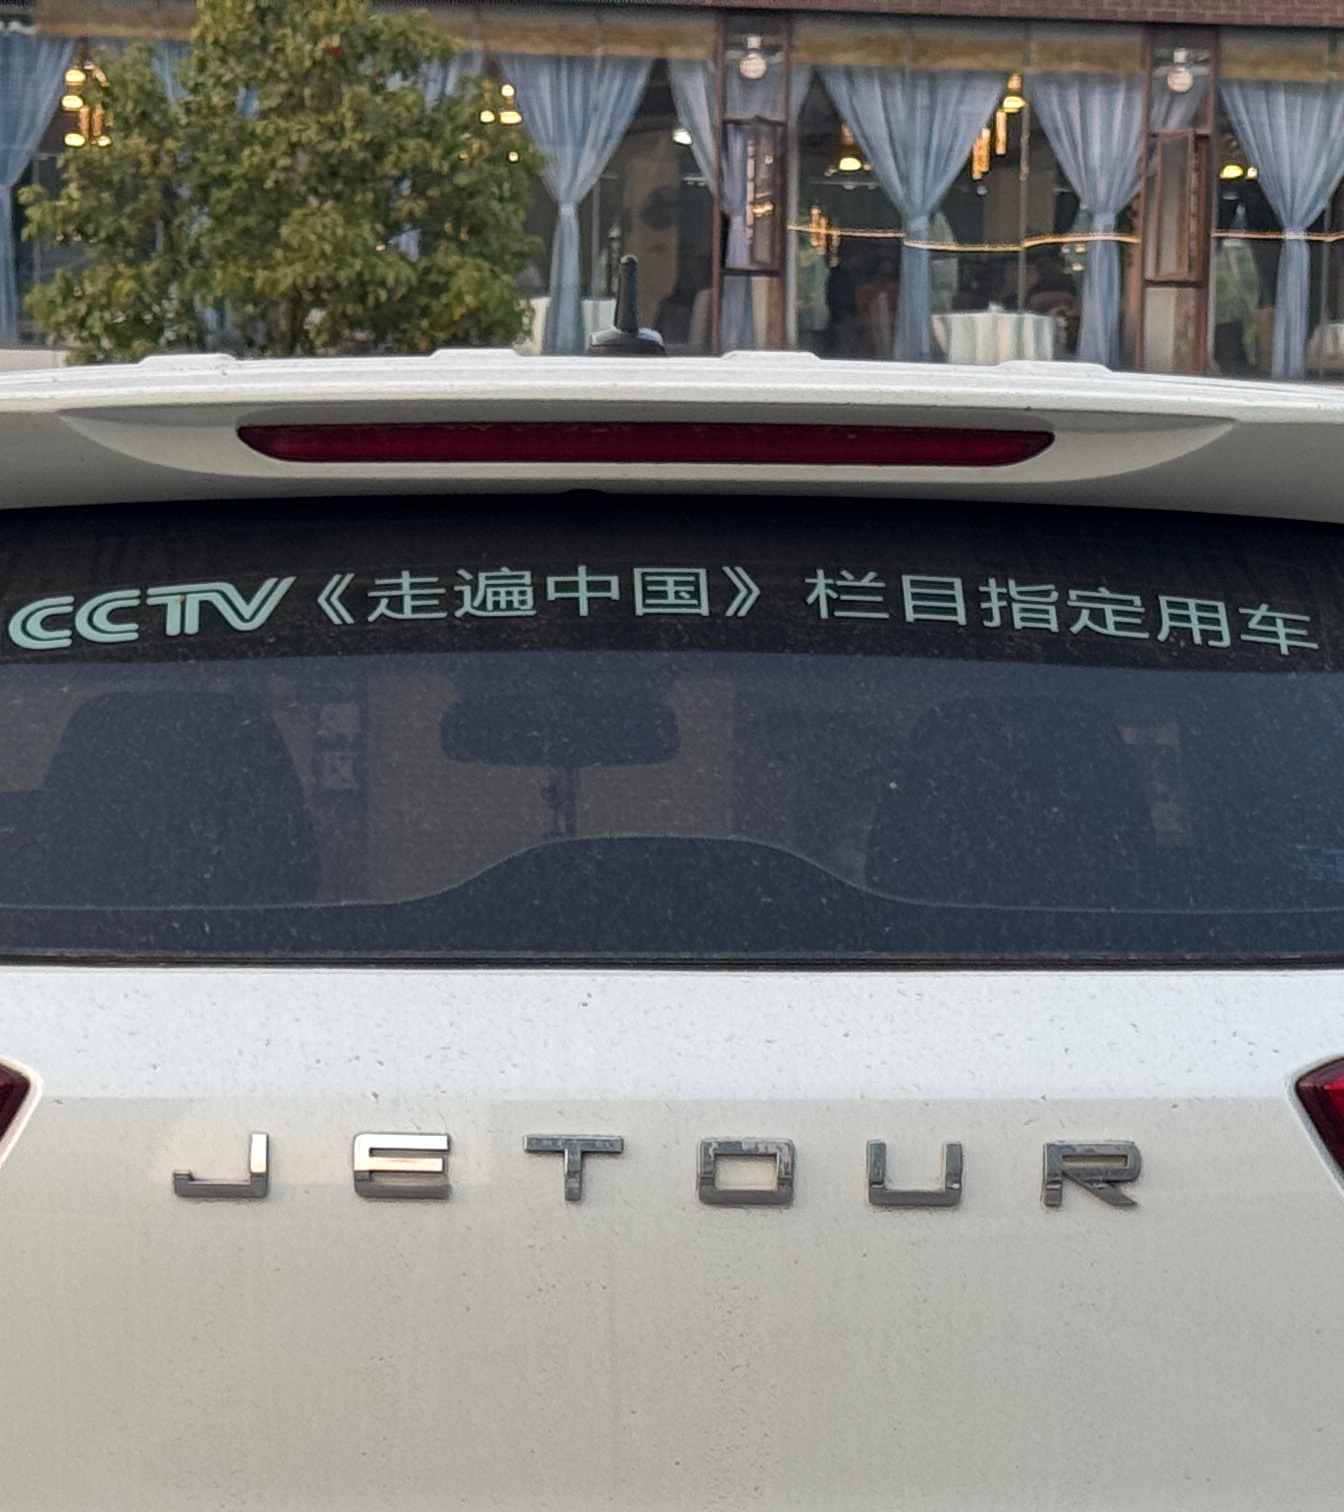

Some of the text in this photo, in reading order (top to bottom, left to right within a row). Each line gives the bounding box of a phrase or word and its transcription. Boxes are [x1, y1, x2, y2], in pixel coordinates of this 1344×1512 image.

[8, 564, 1320, 656] CCTV 《走遍中国》 栏目指定用车
[172, 1131, 1144, 1210] JETOUR
